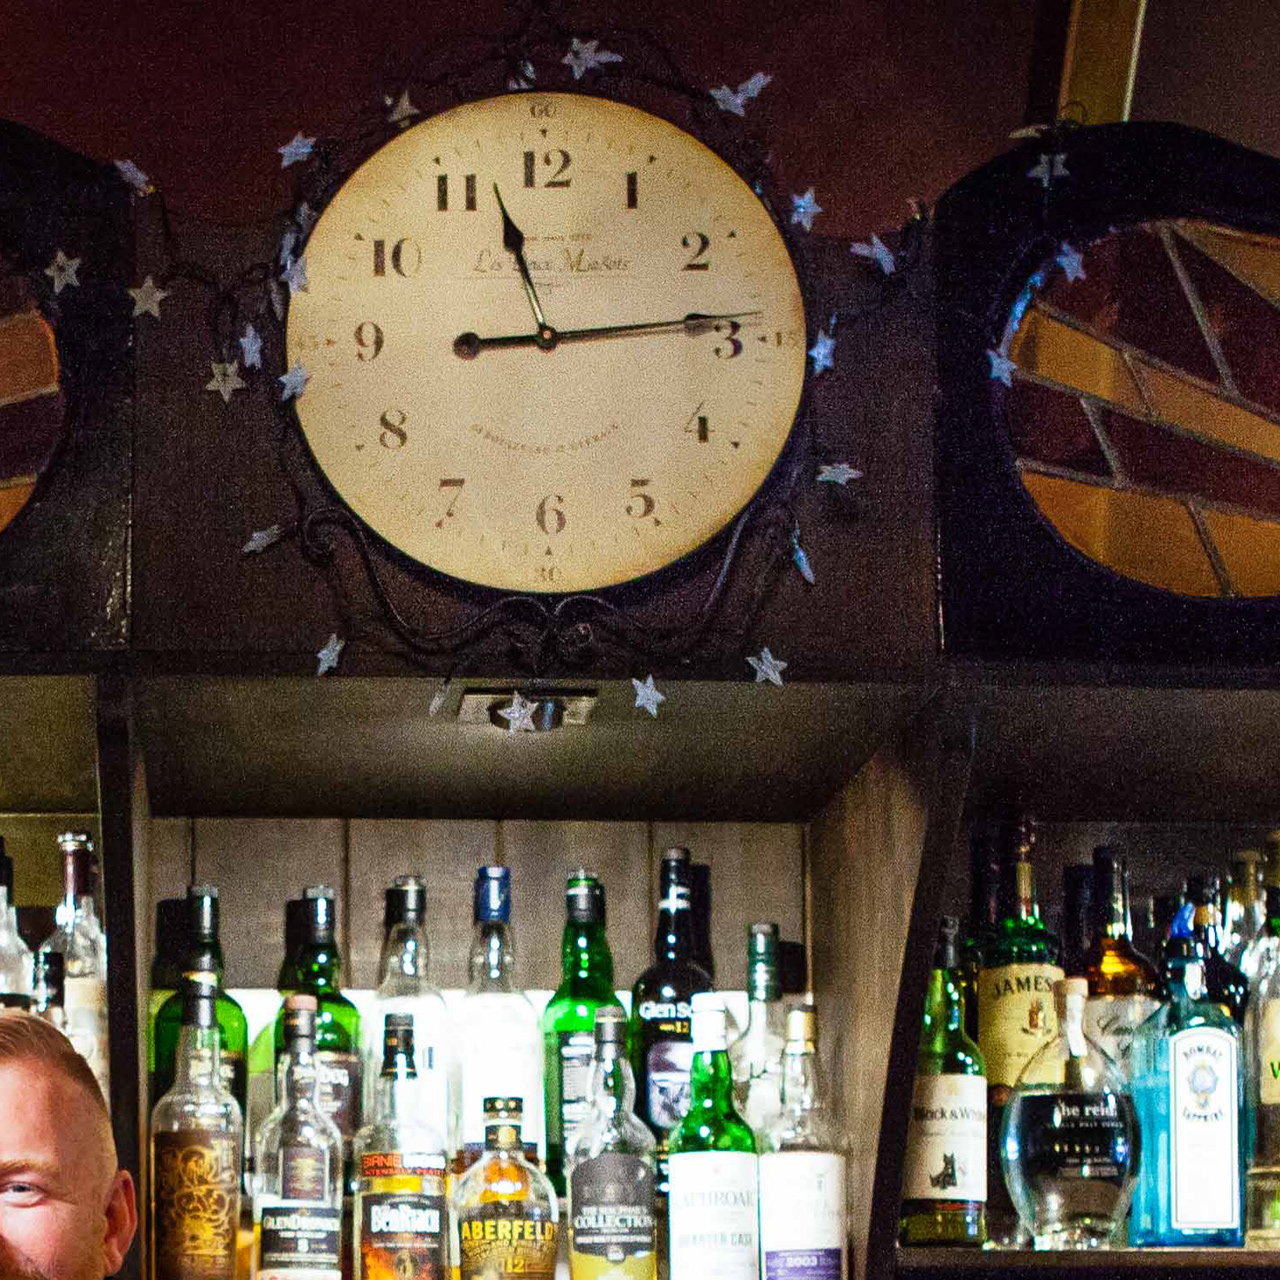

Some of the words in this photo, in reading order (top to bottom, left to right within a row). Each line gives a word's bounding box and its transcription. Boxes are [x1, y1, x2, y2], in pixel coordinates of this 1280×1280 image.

[522, 150, 572, 189] 12
[437, 174, 478, 211] 11
[624, 172, 638, 209] 1
[371, 237, 421, 277] 10
[681, 231, 711, 271] 2
[354, 321, 385, 362] 9
[712, 321, 743, 359] 3
[379, 409, 409, 449] 8
[683, 401, 714, 443] 4
[439, 478, 465, 517] 7
[536, 495, 567, 535] 6
[625, 478, 656, 518] 5
[995, 975, 1054, 996] JAMES
[461, 1220, 558, 1241] ABERFELD
